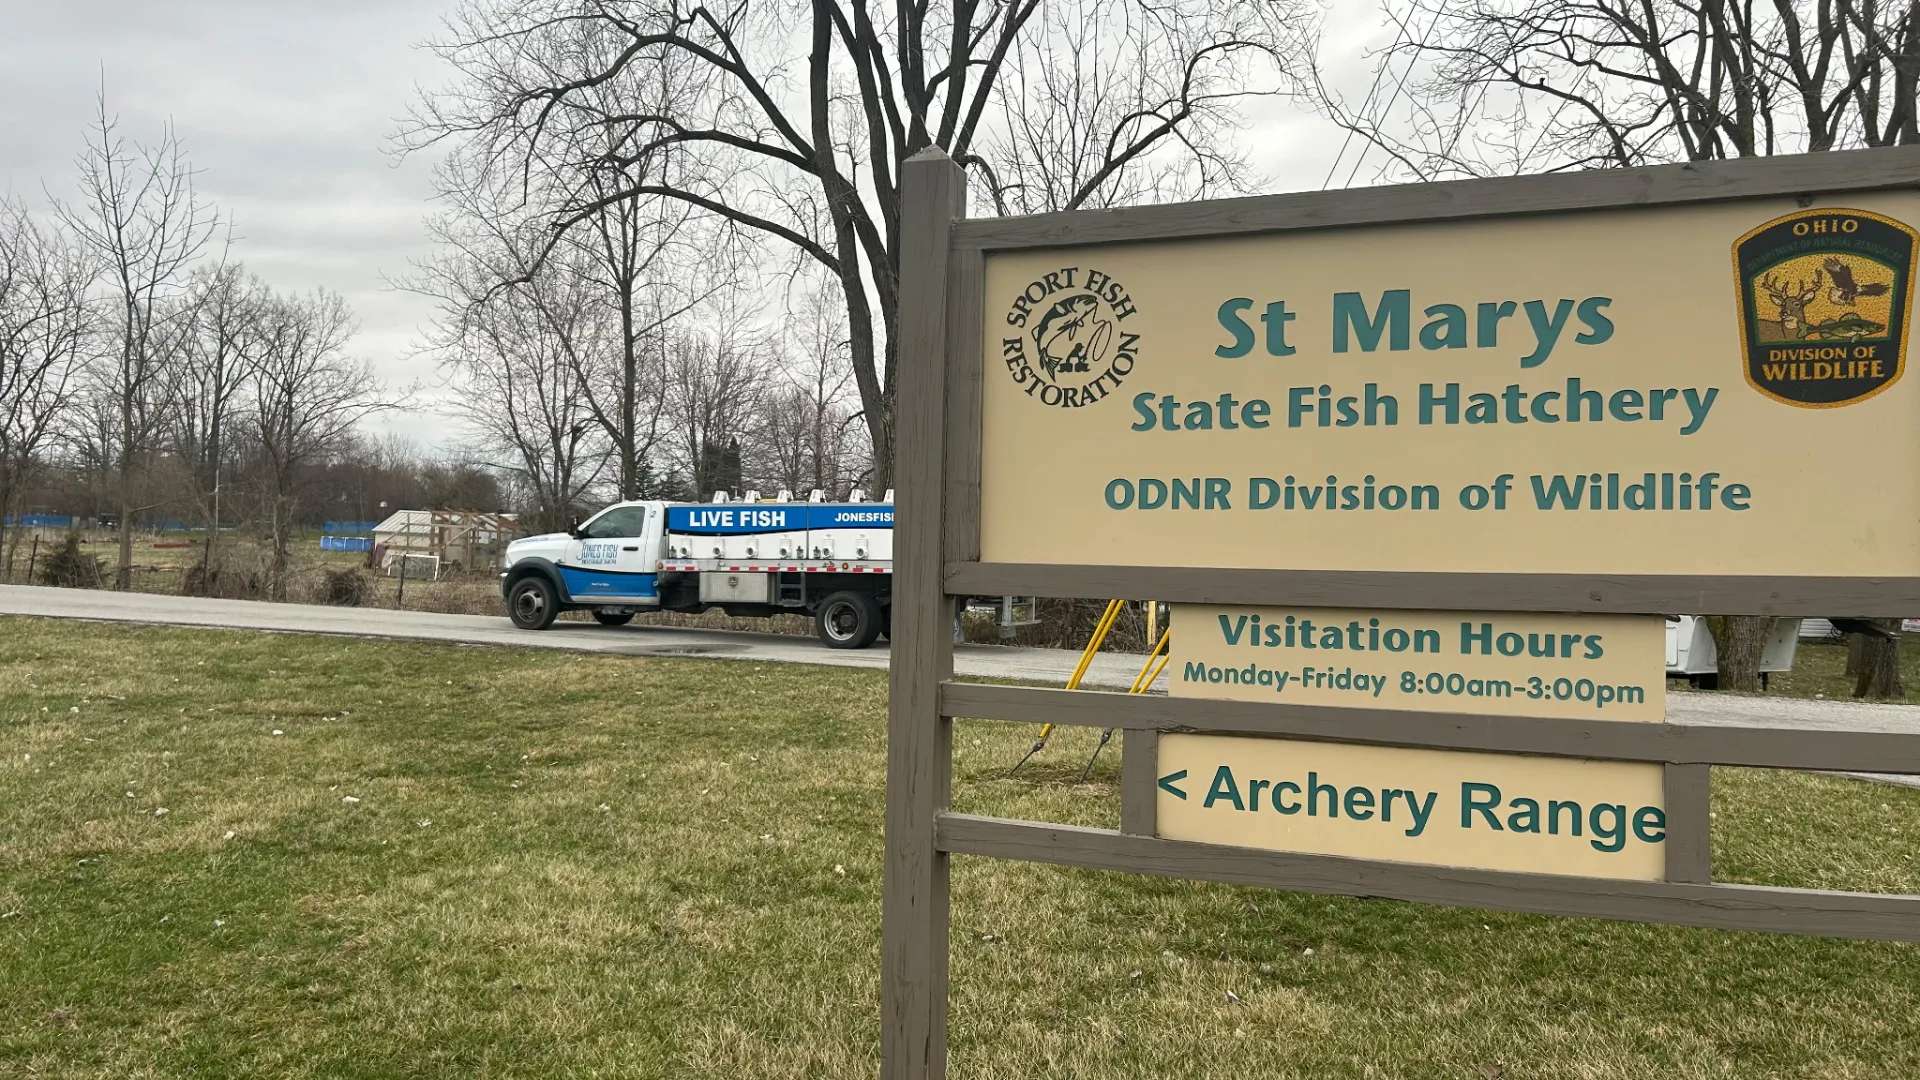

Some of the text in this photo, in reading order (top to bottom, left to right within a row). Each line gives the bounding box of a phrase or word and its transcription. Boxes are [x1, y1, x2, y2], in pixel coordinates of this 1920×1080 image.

[1793, 219, 1858, 236] OHIO
[1006, 267, 1137, 329] SPORT FISH
[1215, 289, 1615, 369] St Marys
[1002, 331, 1141, 408] RESTORATION
[1762, 360, 1885, 381] WILDLIFE
[1769, 345, 1878, 361] DIVISION OF
[1131, 377, 1720, 436] State Fish Hatchery
[1104, 472, 1753, 511] ODNR Division of Wildlife
[689, 510, 786, 528] LIVE FISH
[1217, 613, 1605, 661] Visitation Hours
[1183, 662, 1647, 708] Monday-Friday 8:00am-3:00pm
[1203, 765, 1666, 853] Archery Range
